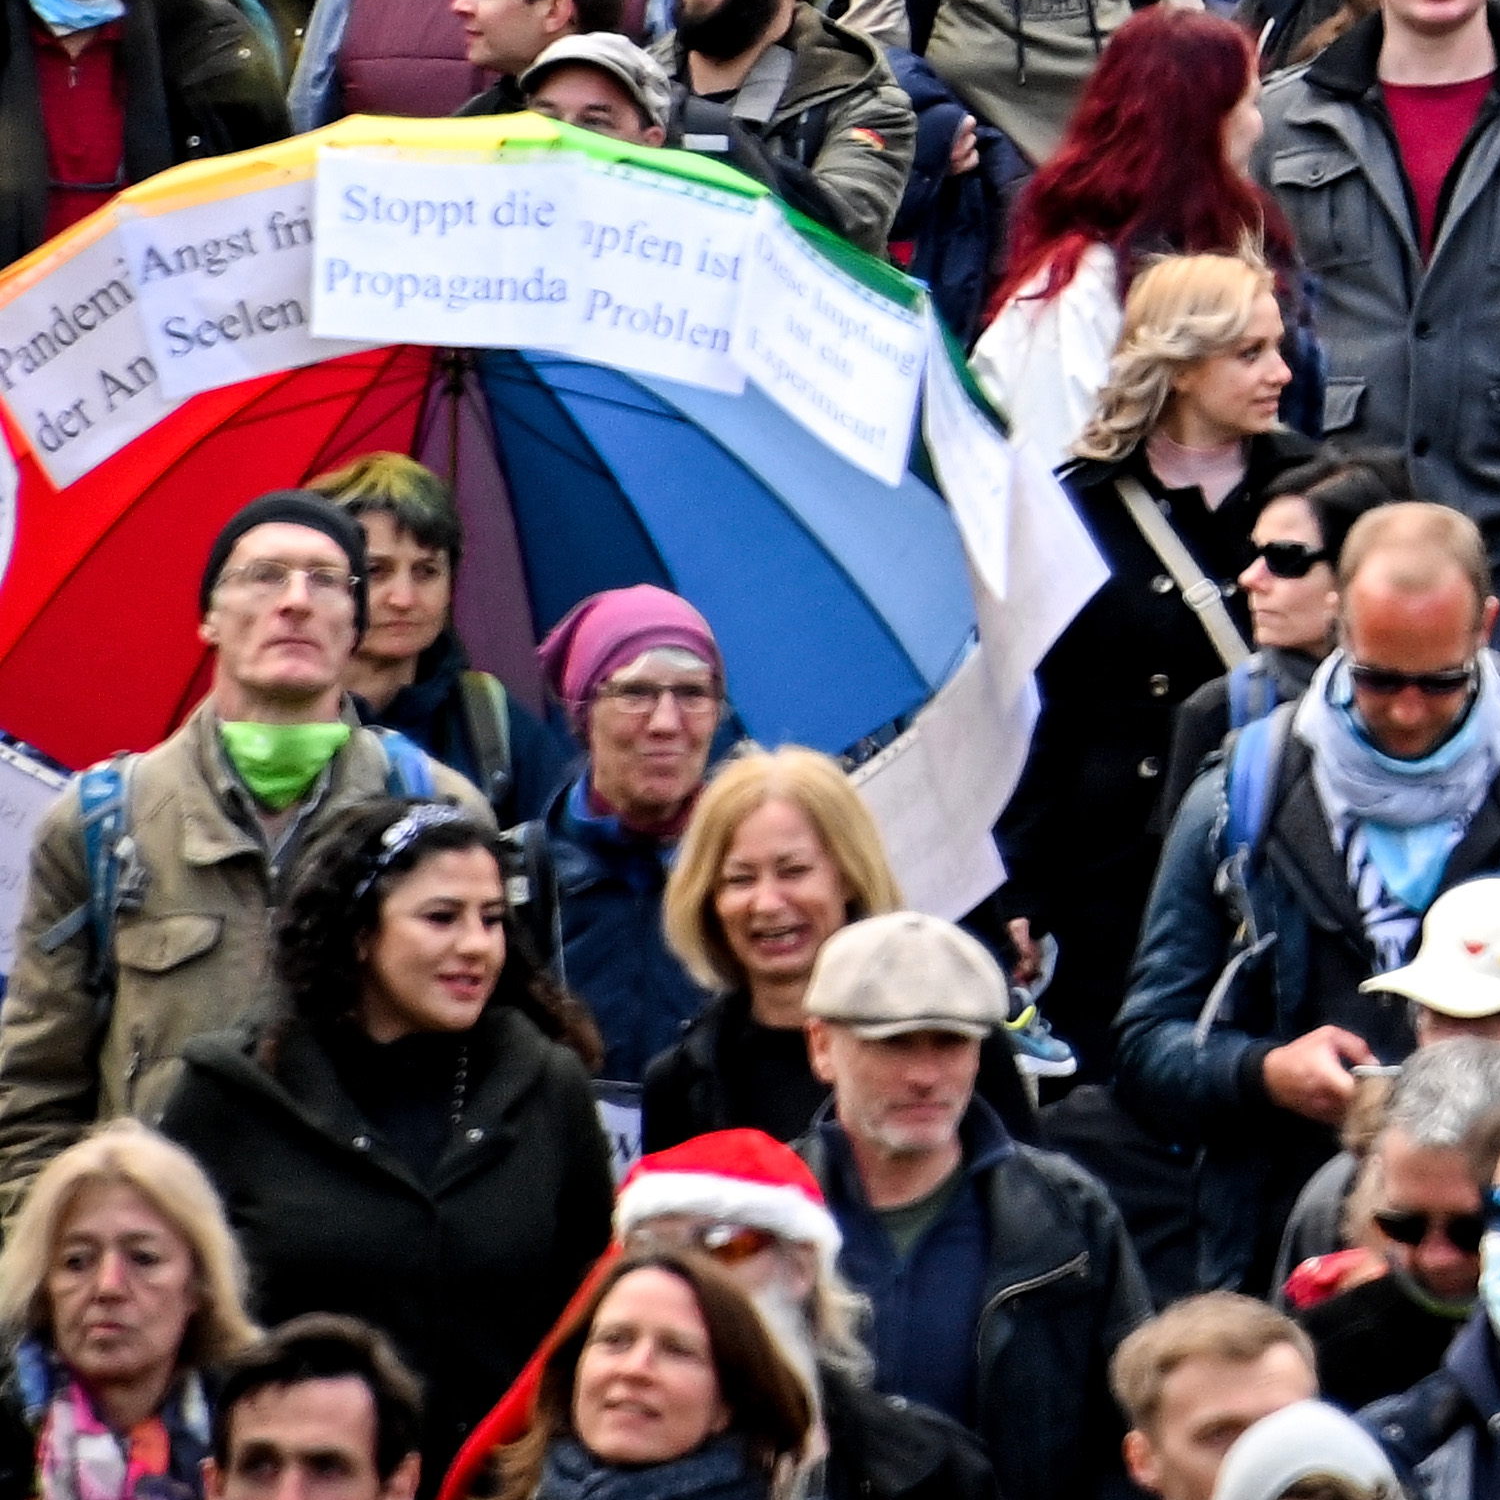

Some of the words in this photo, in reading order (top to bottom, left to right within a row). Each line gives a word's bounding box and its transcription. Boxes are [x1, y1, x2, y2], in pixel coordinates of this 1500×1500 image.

[340, 183, 479, 237] Stoppt
[492, 189, 557, 229] die
[140, 224, 259, 285] Angst
[696, 235, 742, 283] ist
[324, 256, 569, 310] Propaganda
[162, 296, 308, 359] Seelen
[36, 397, 94, 453] der
